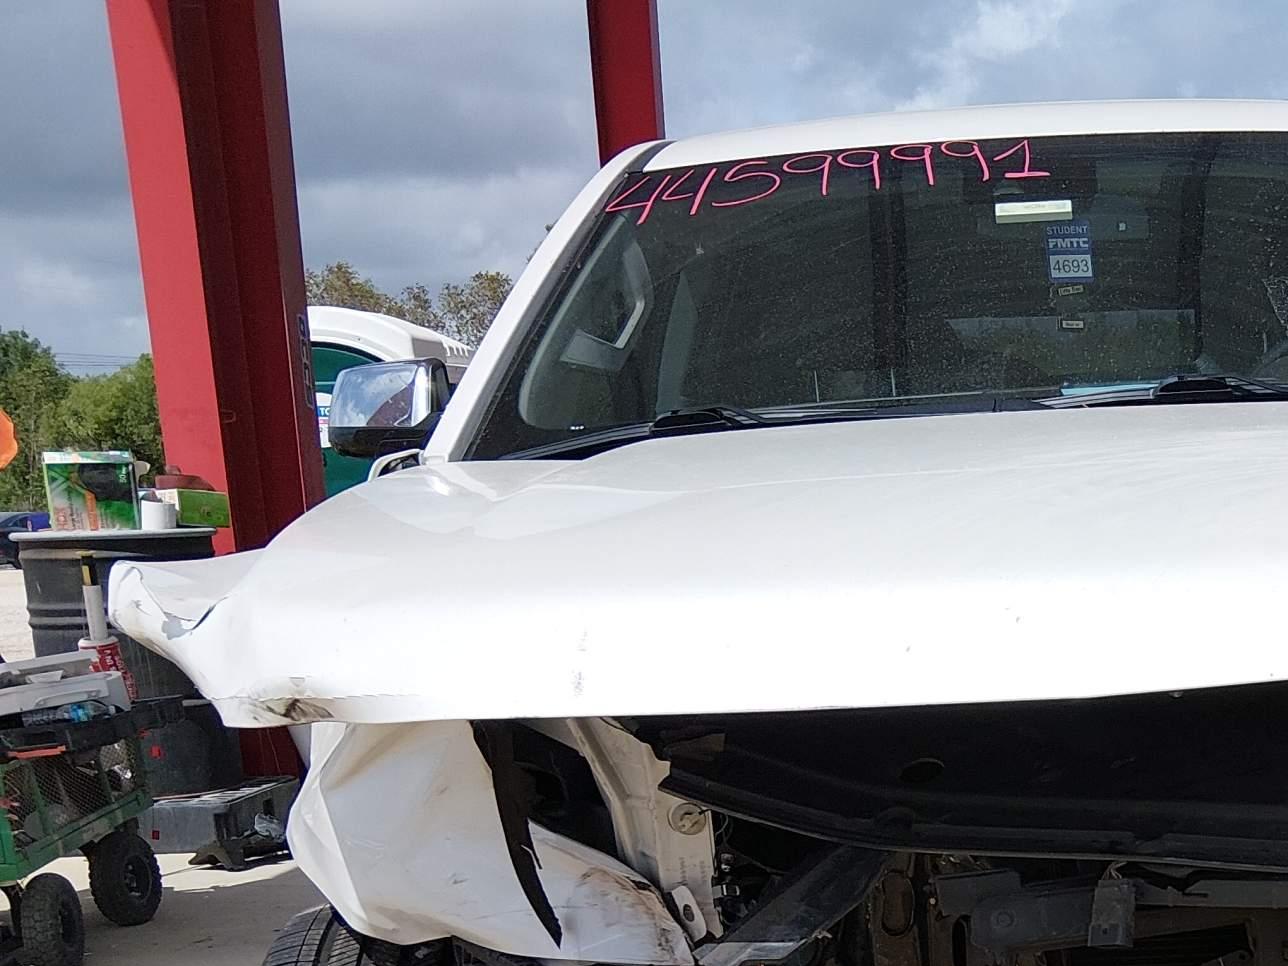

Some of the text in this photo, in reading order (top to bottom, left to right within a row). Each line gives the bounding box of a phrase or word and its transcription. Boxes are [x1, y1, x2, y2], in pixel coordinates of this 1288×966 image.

[605, 139, 1051, 225] 44599991
[1046, 225, 1088, 235] STUDENT
[1048, 238, 1089, 249] FMTC
[1053, 259, 1090, 273] 4693
